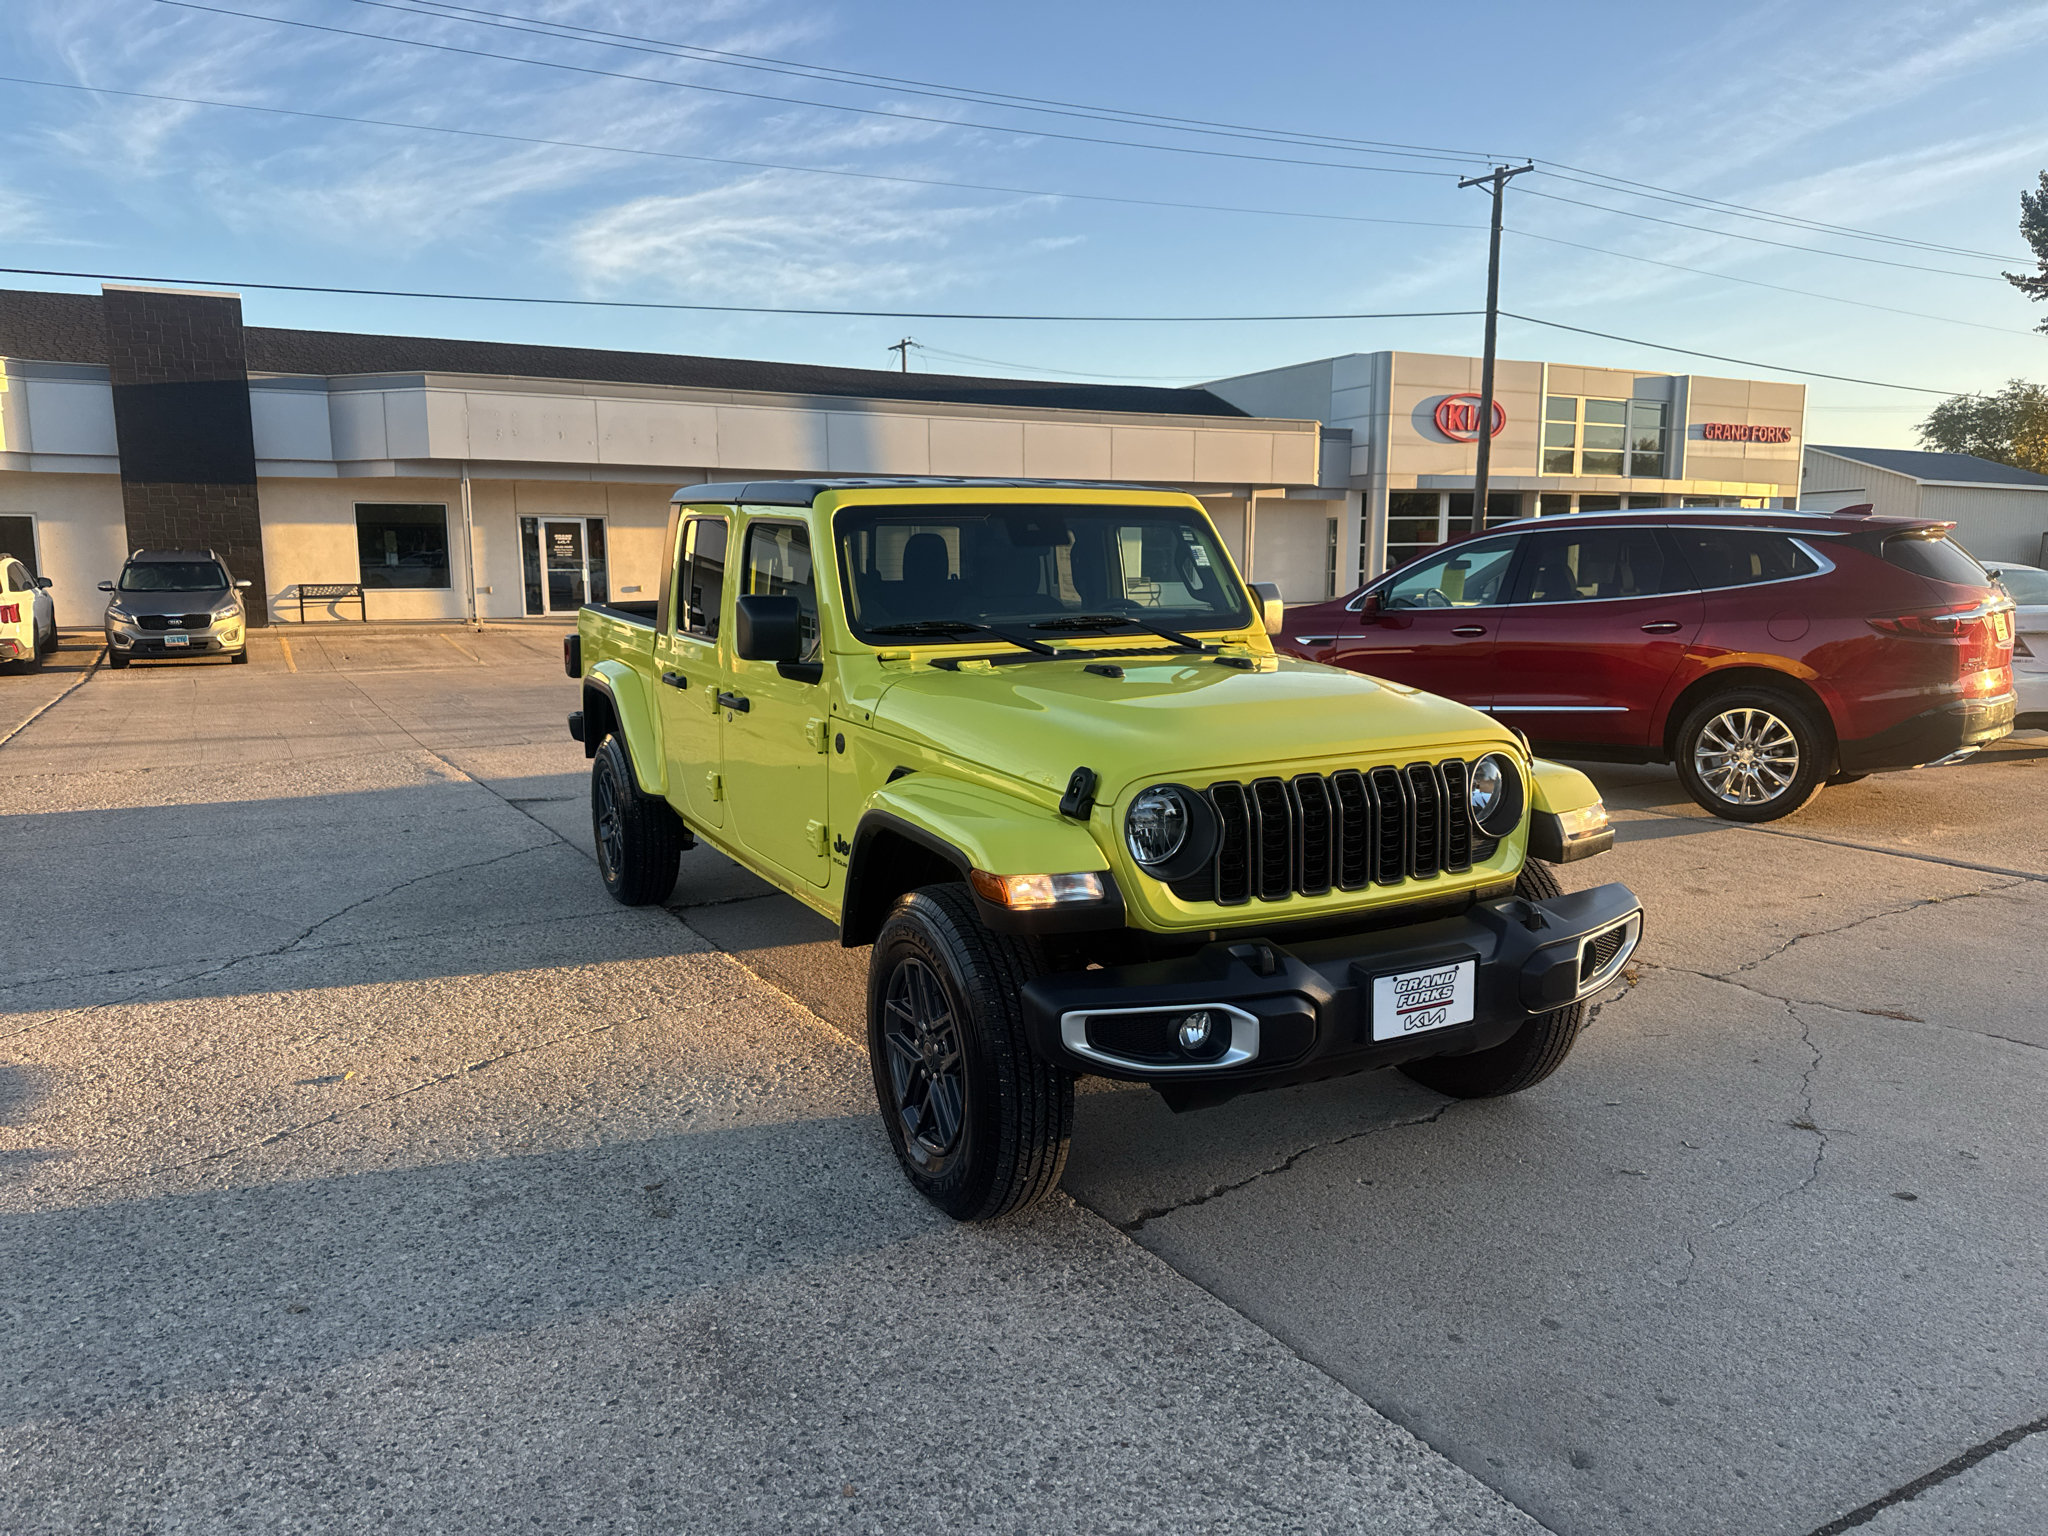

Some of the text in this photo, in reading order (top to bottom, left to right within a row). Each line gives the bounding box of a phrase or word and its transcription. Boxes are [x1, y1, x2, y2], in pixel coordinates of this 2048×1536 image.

[1446, 404, 1494, 432] KI
[1704, 423, 1791, 443] GRAND FORKS
[1394, 970, 1457, 994] GRAND
[1396, 985, 1454, 1008] FORKS
